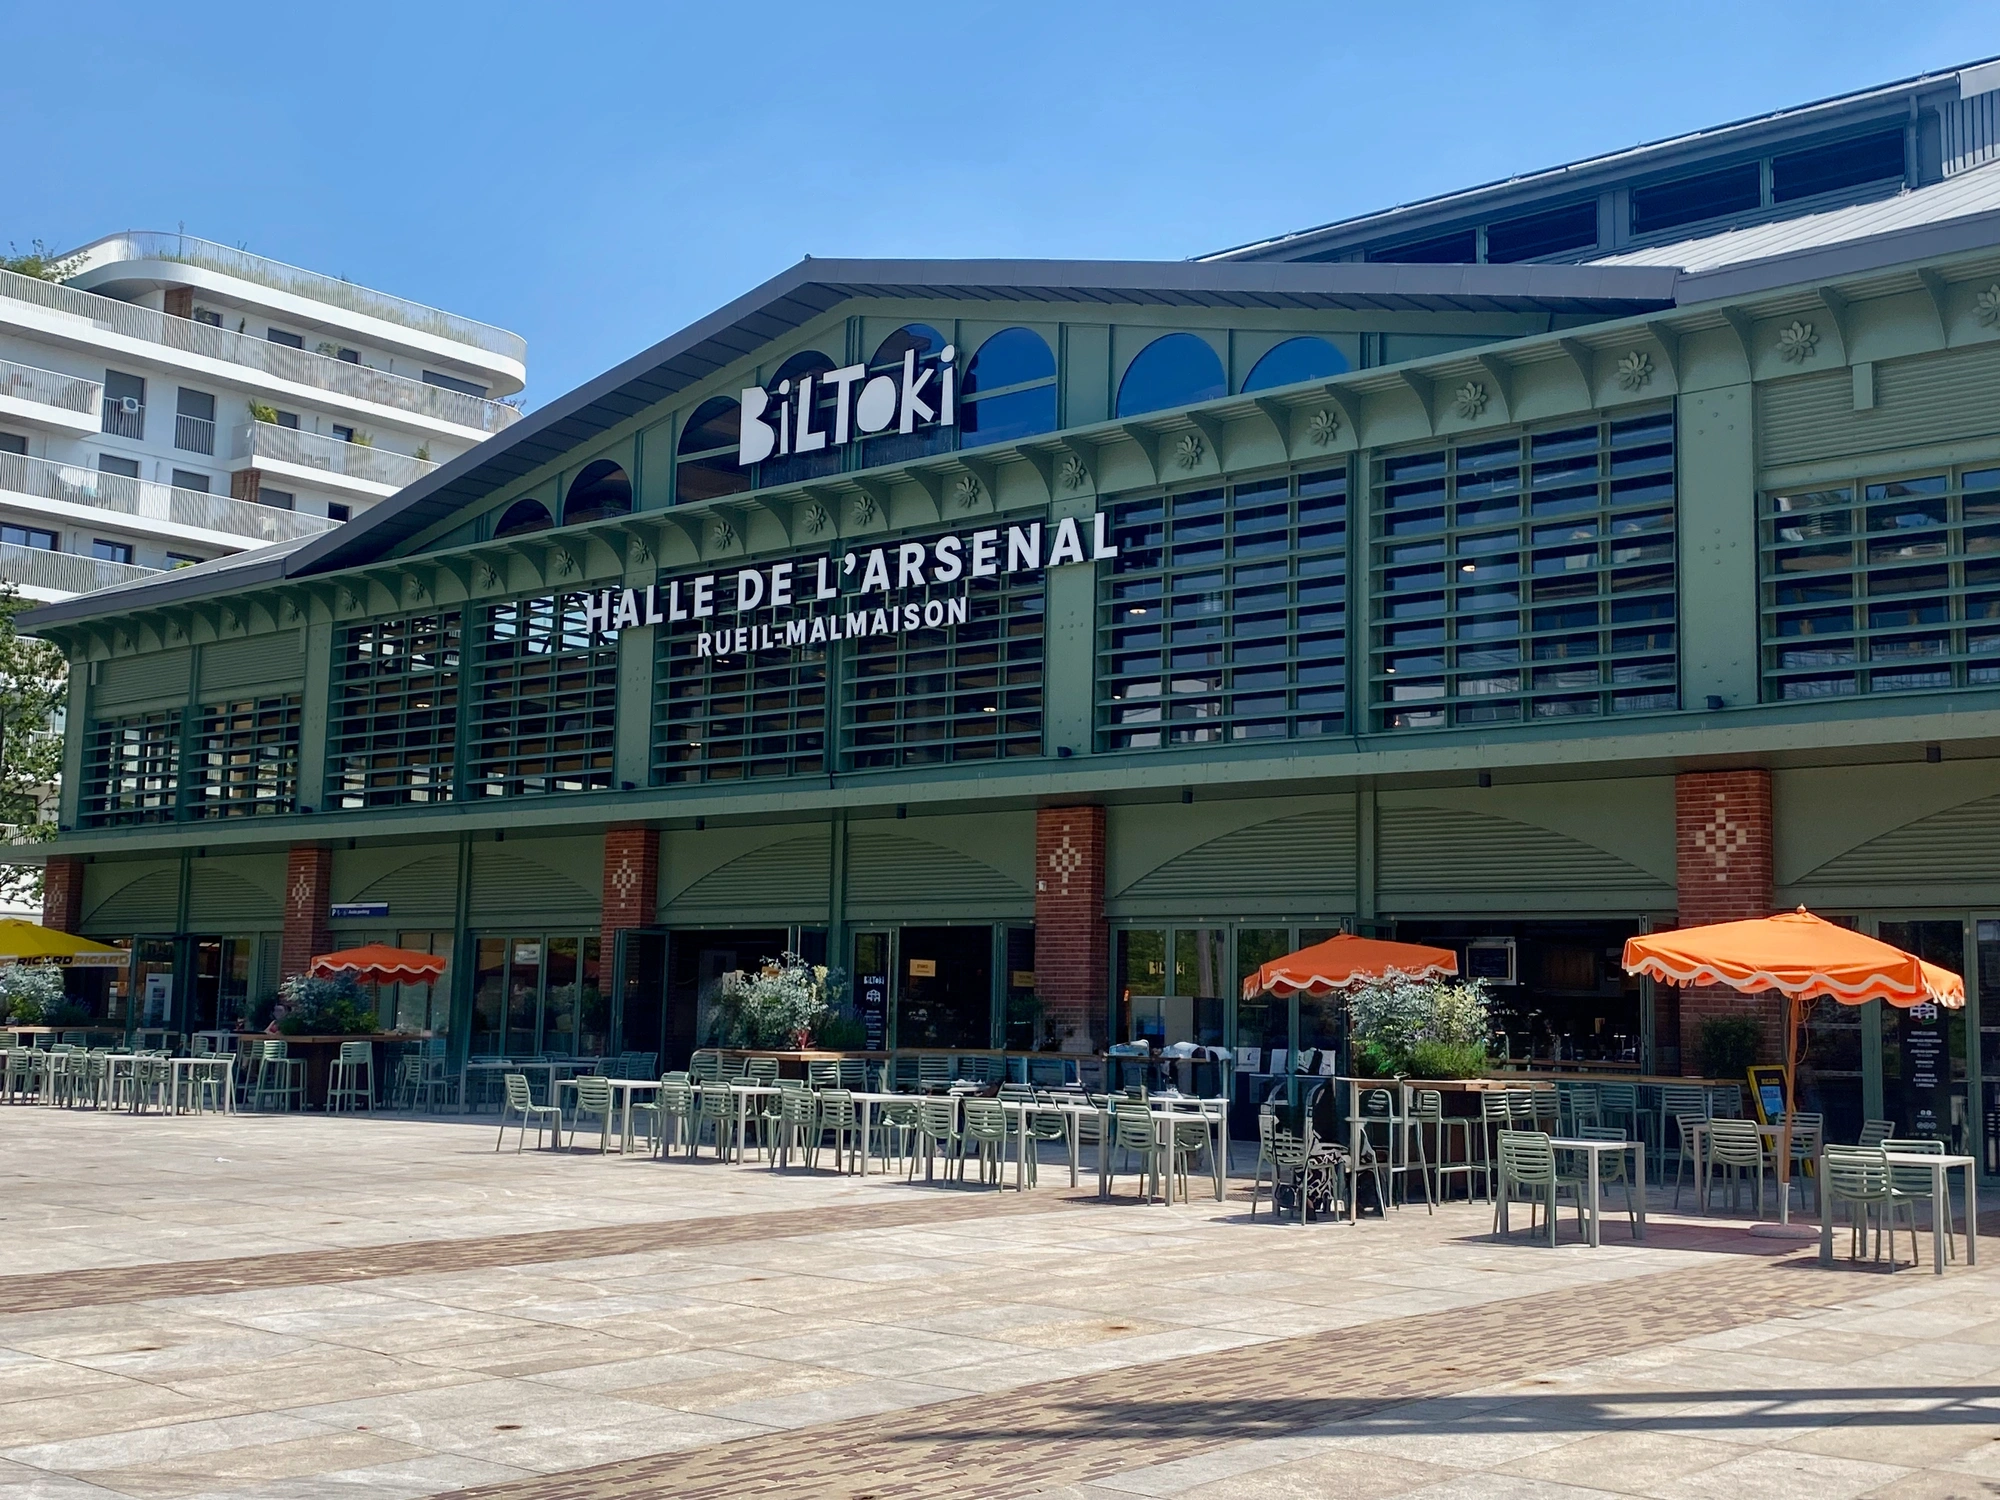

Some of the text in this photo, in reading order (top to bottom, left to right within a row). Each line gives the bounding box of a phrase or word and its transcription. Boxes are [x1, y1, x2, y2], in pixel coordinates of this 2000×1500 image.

[586, 511, 1119, 634] HALLE DE L'ARSENAL
[697, 596, 968, 658] RUEIL-MALMAISON
[74, 955, 129, 965] RICARD
[1149, 961, 1186, 975] BiLki
